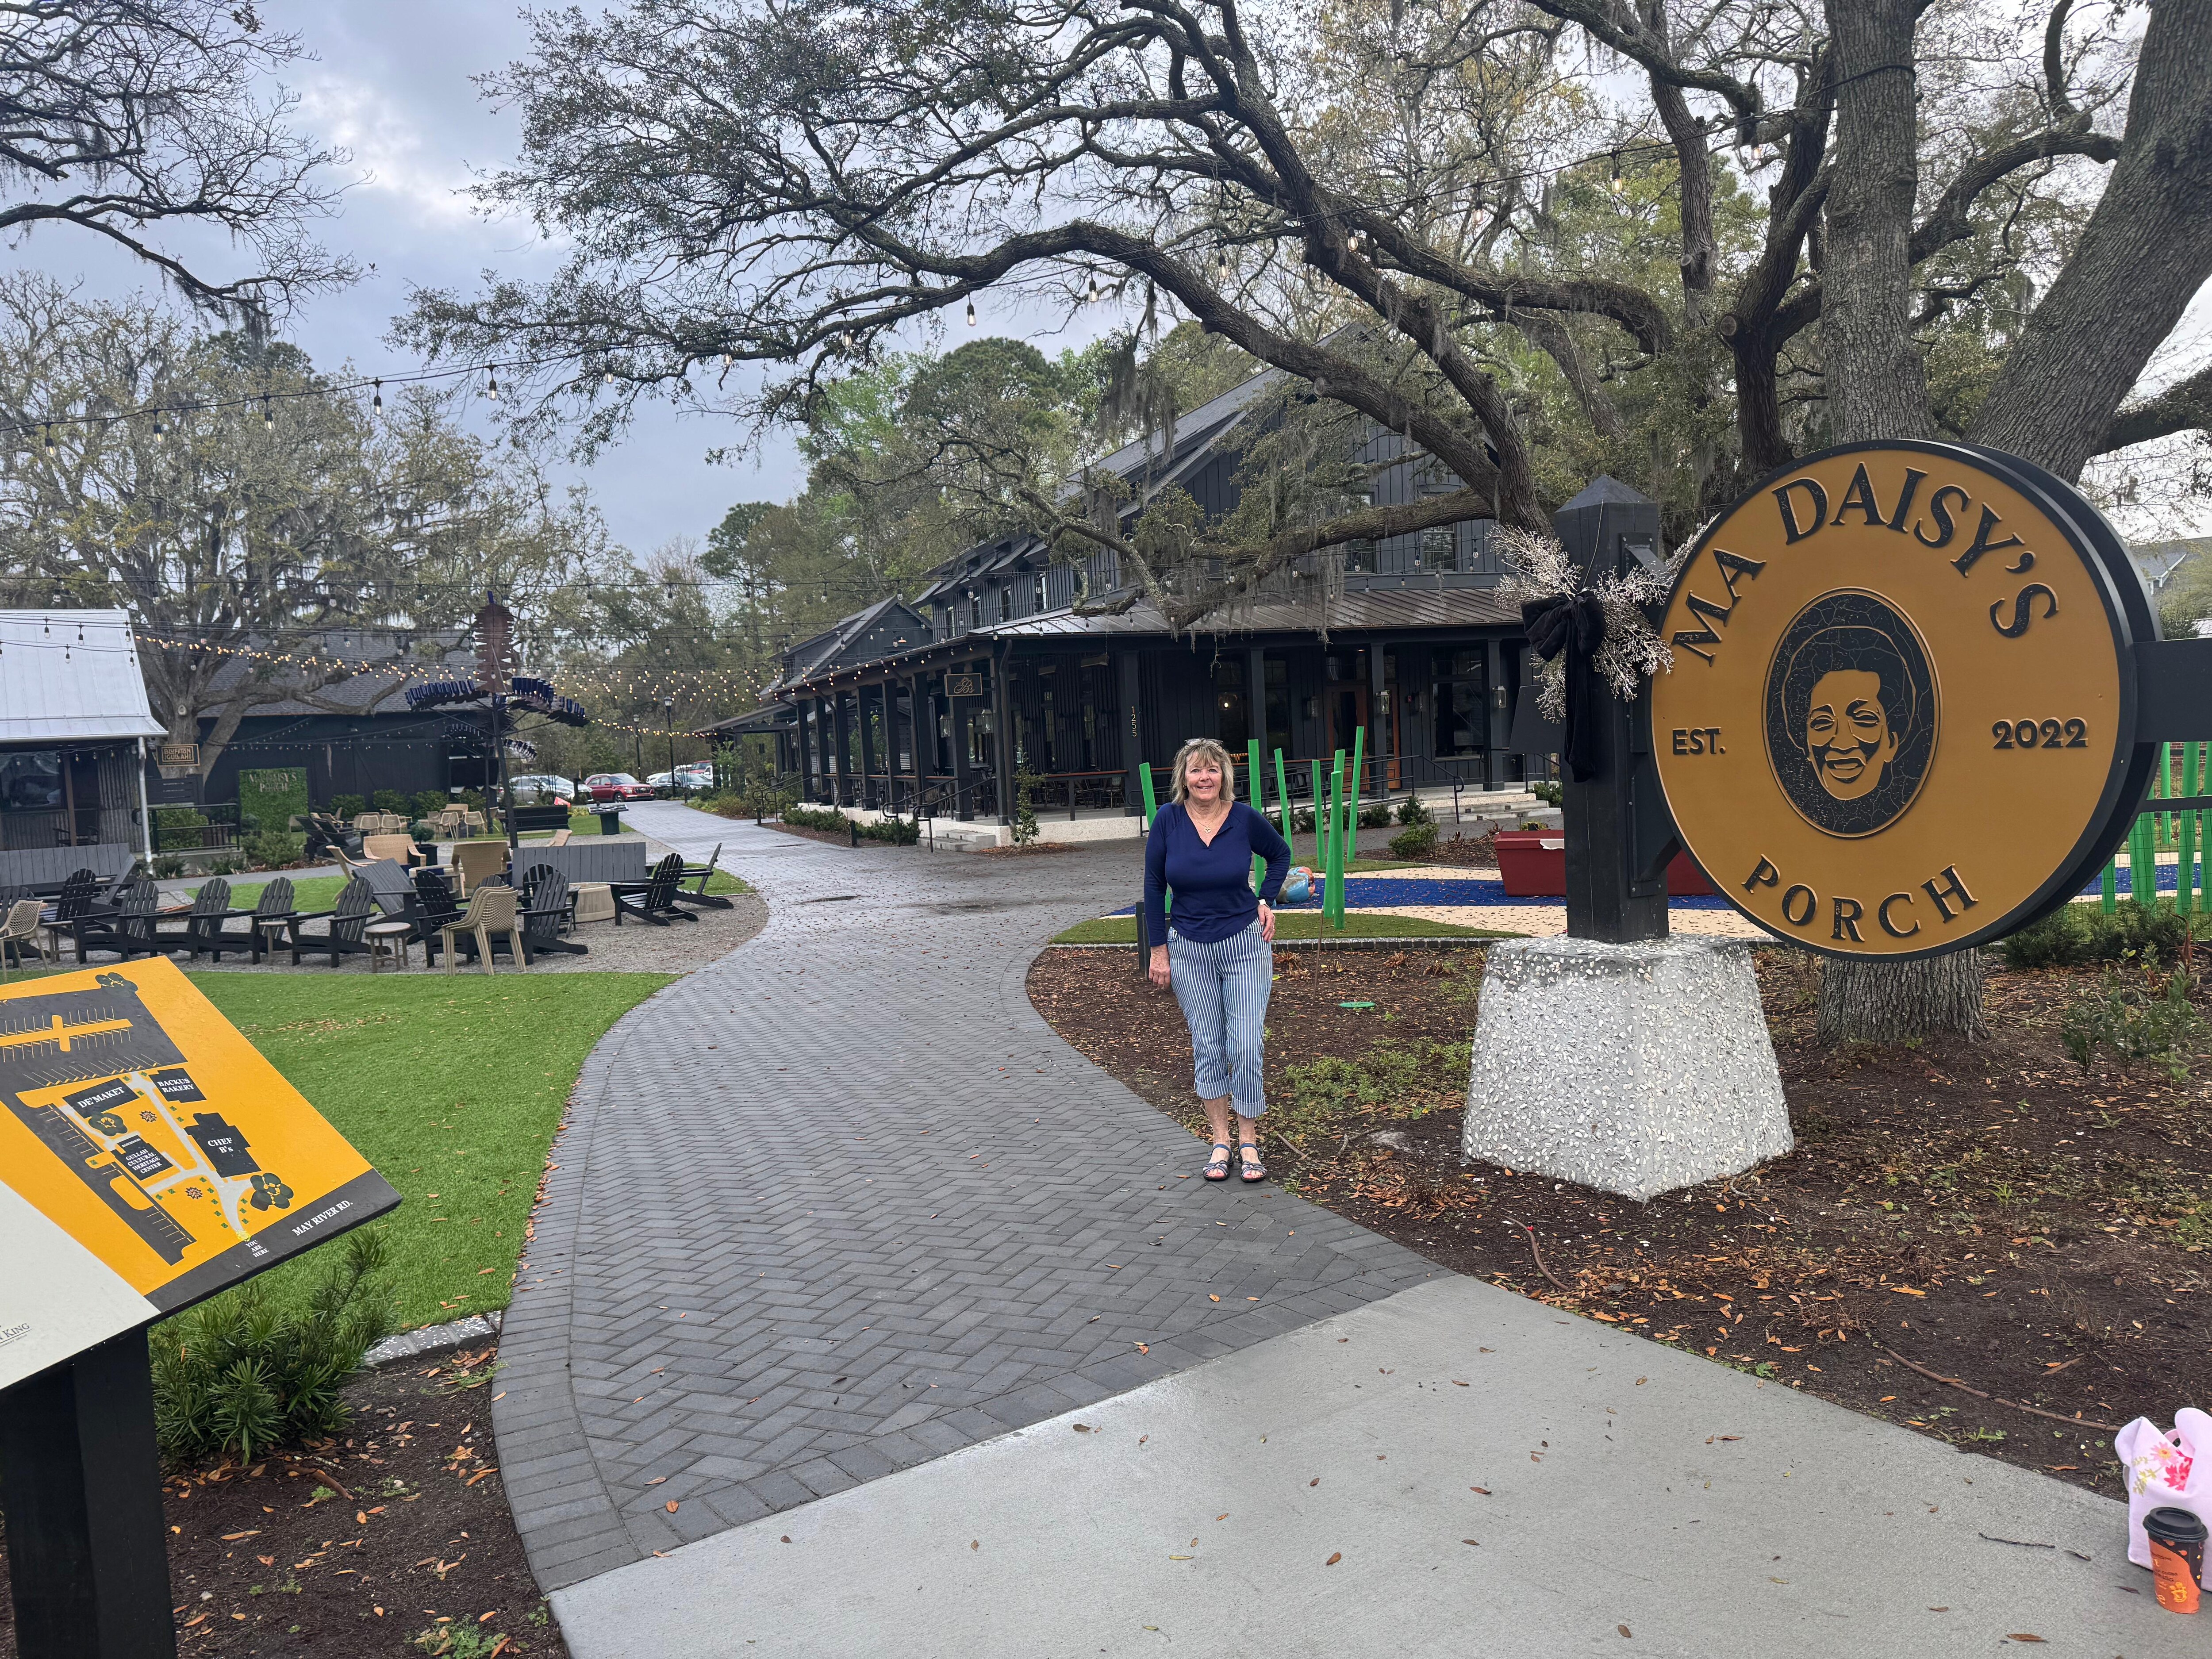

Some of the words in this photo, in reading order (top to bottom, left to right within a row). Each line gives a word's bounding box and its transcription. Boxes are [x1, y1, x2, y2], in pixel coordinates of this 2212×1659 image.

[1672, 548, 1766, 665] MA
[1992, 718, 2088, 749] 2022
[1672, 727, 1726, 755] EST.
[1742, 854, 1978, 941] PORCH
[157, 1078, 190, 1087] BACKUS
[161, 1084, 194, 1093] BAKERY
[207, 1137, 232, 1147] CHEF
[126, 1149, 148, 1160] GULLAH
[127, 1152, 156, 1166] CULTURAL
[132, 1156, 160, 1171] HERITAGE
[140, 1162, 162, 1173] CENTER
[292, 1220, 314, 1236] MAY
[311, 1206, 340, 1225] RIVER
[336, 1200, 353, 1211] RD.
[253, 1248, 269, 1258] HERE
